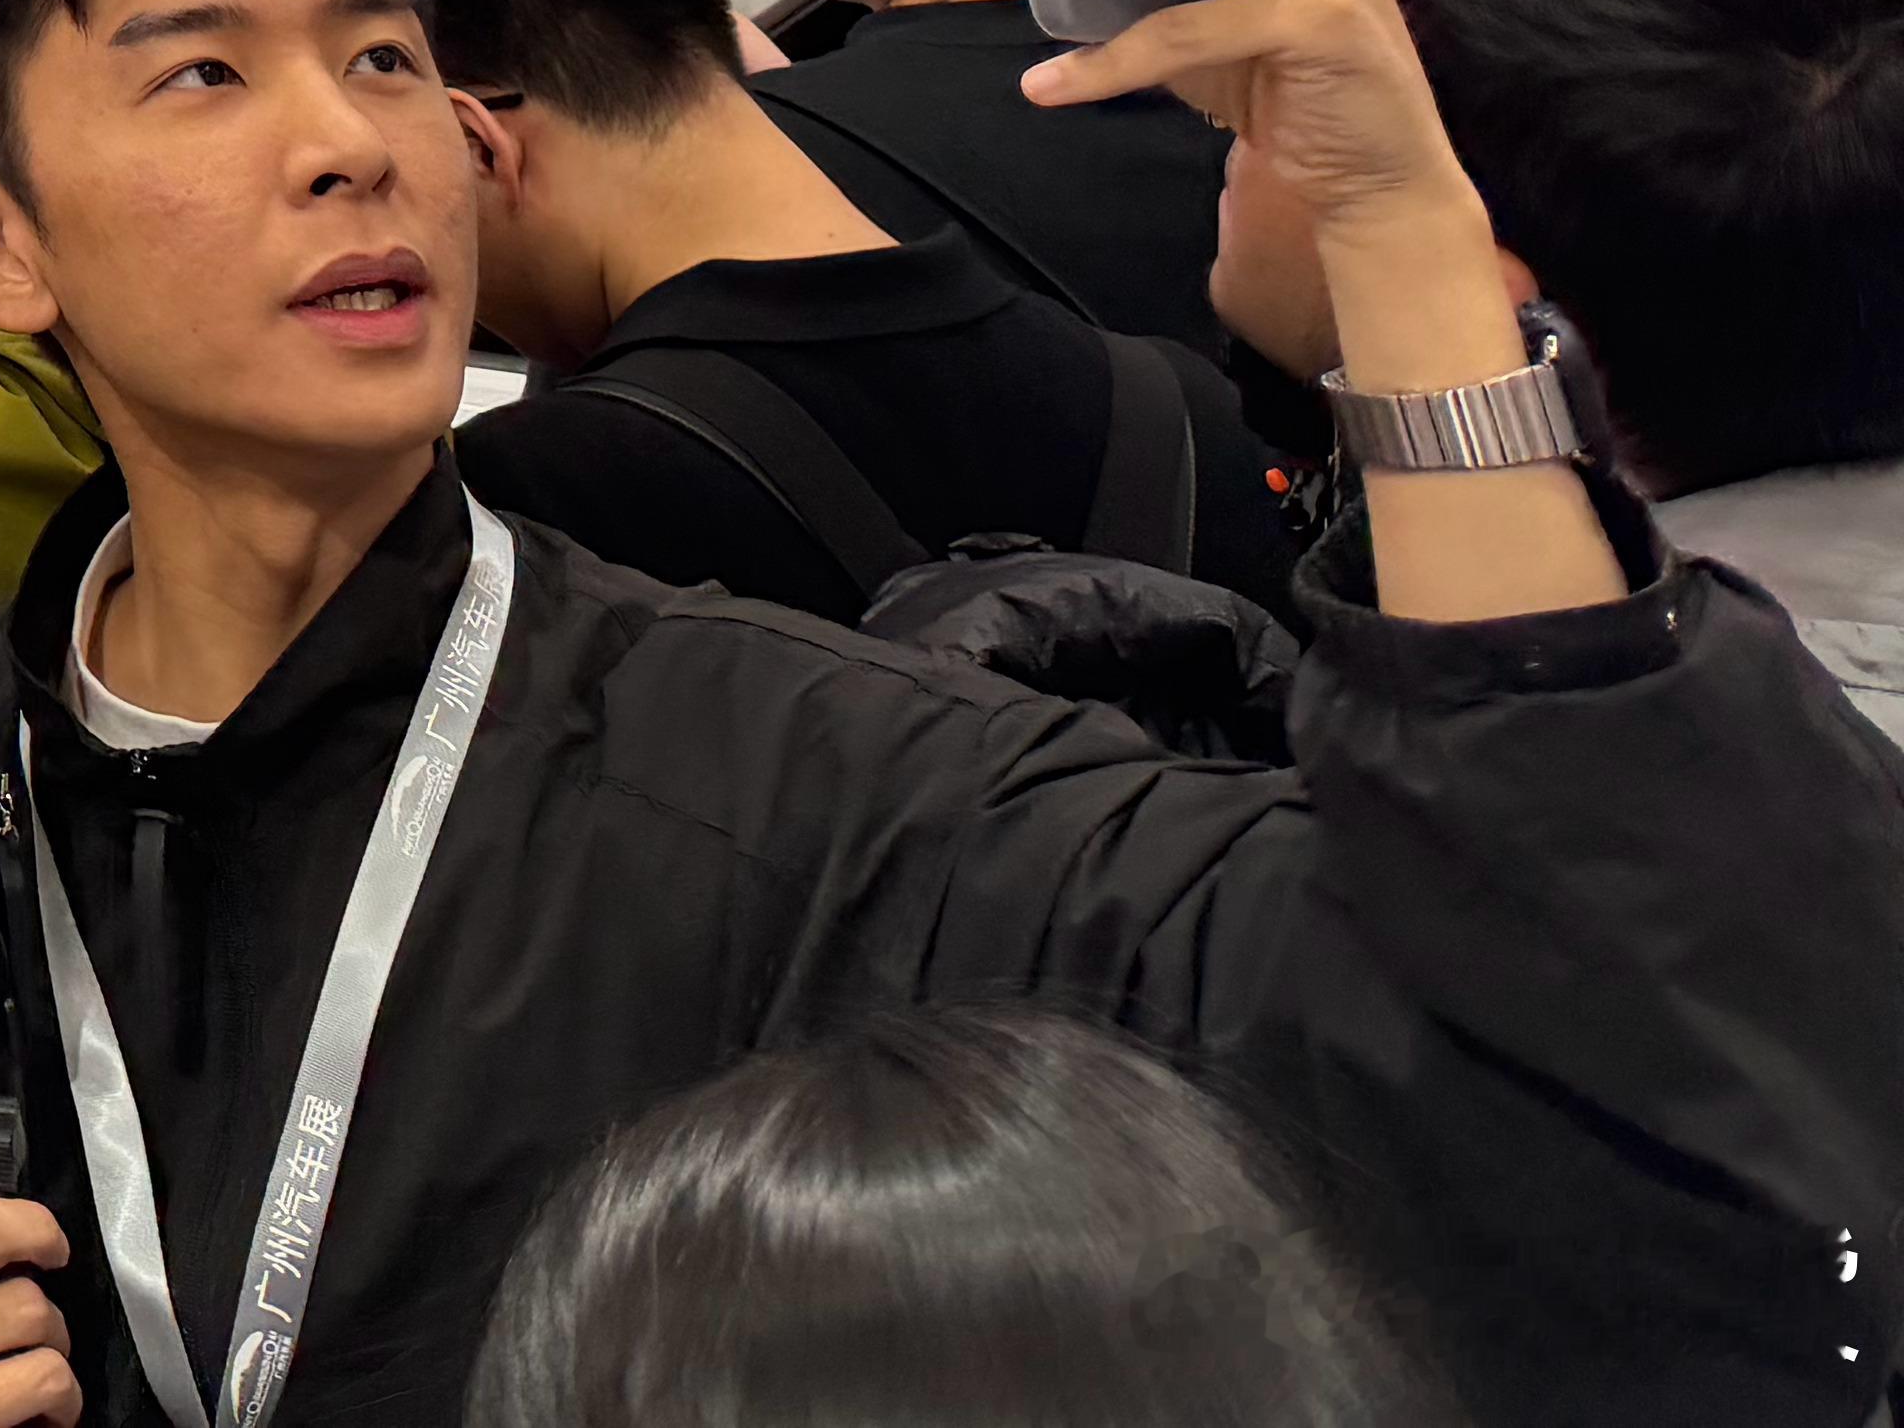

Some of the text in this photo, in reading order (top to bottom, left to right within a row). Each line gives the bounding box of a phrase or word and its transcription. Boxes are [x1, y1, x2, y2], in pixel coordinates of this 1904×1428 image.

[254, 1094, 343, 1324] 广州汽车展
